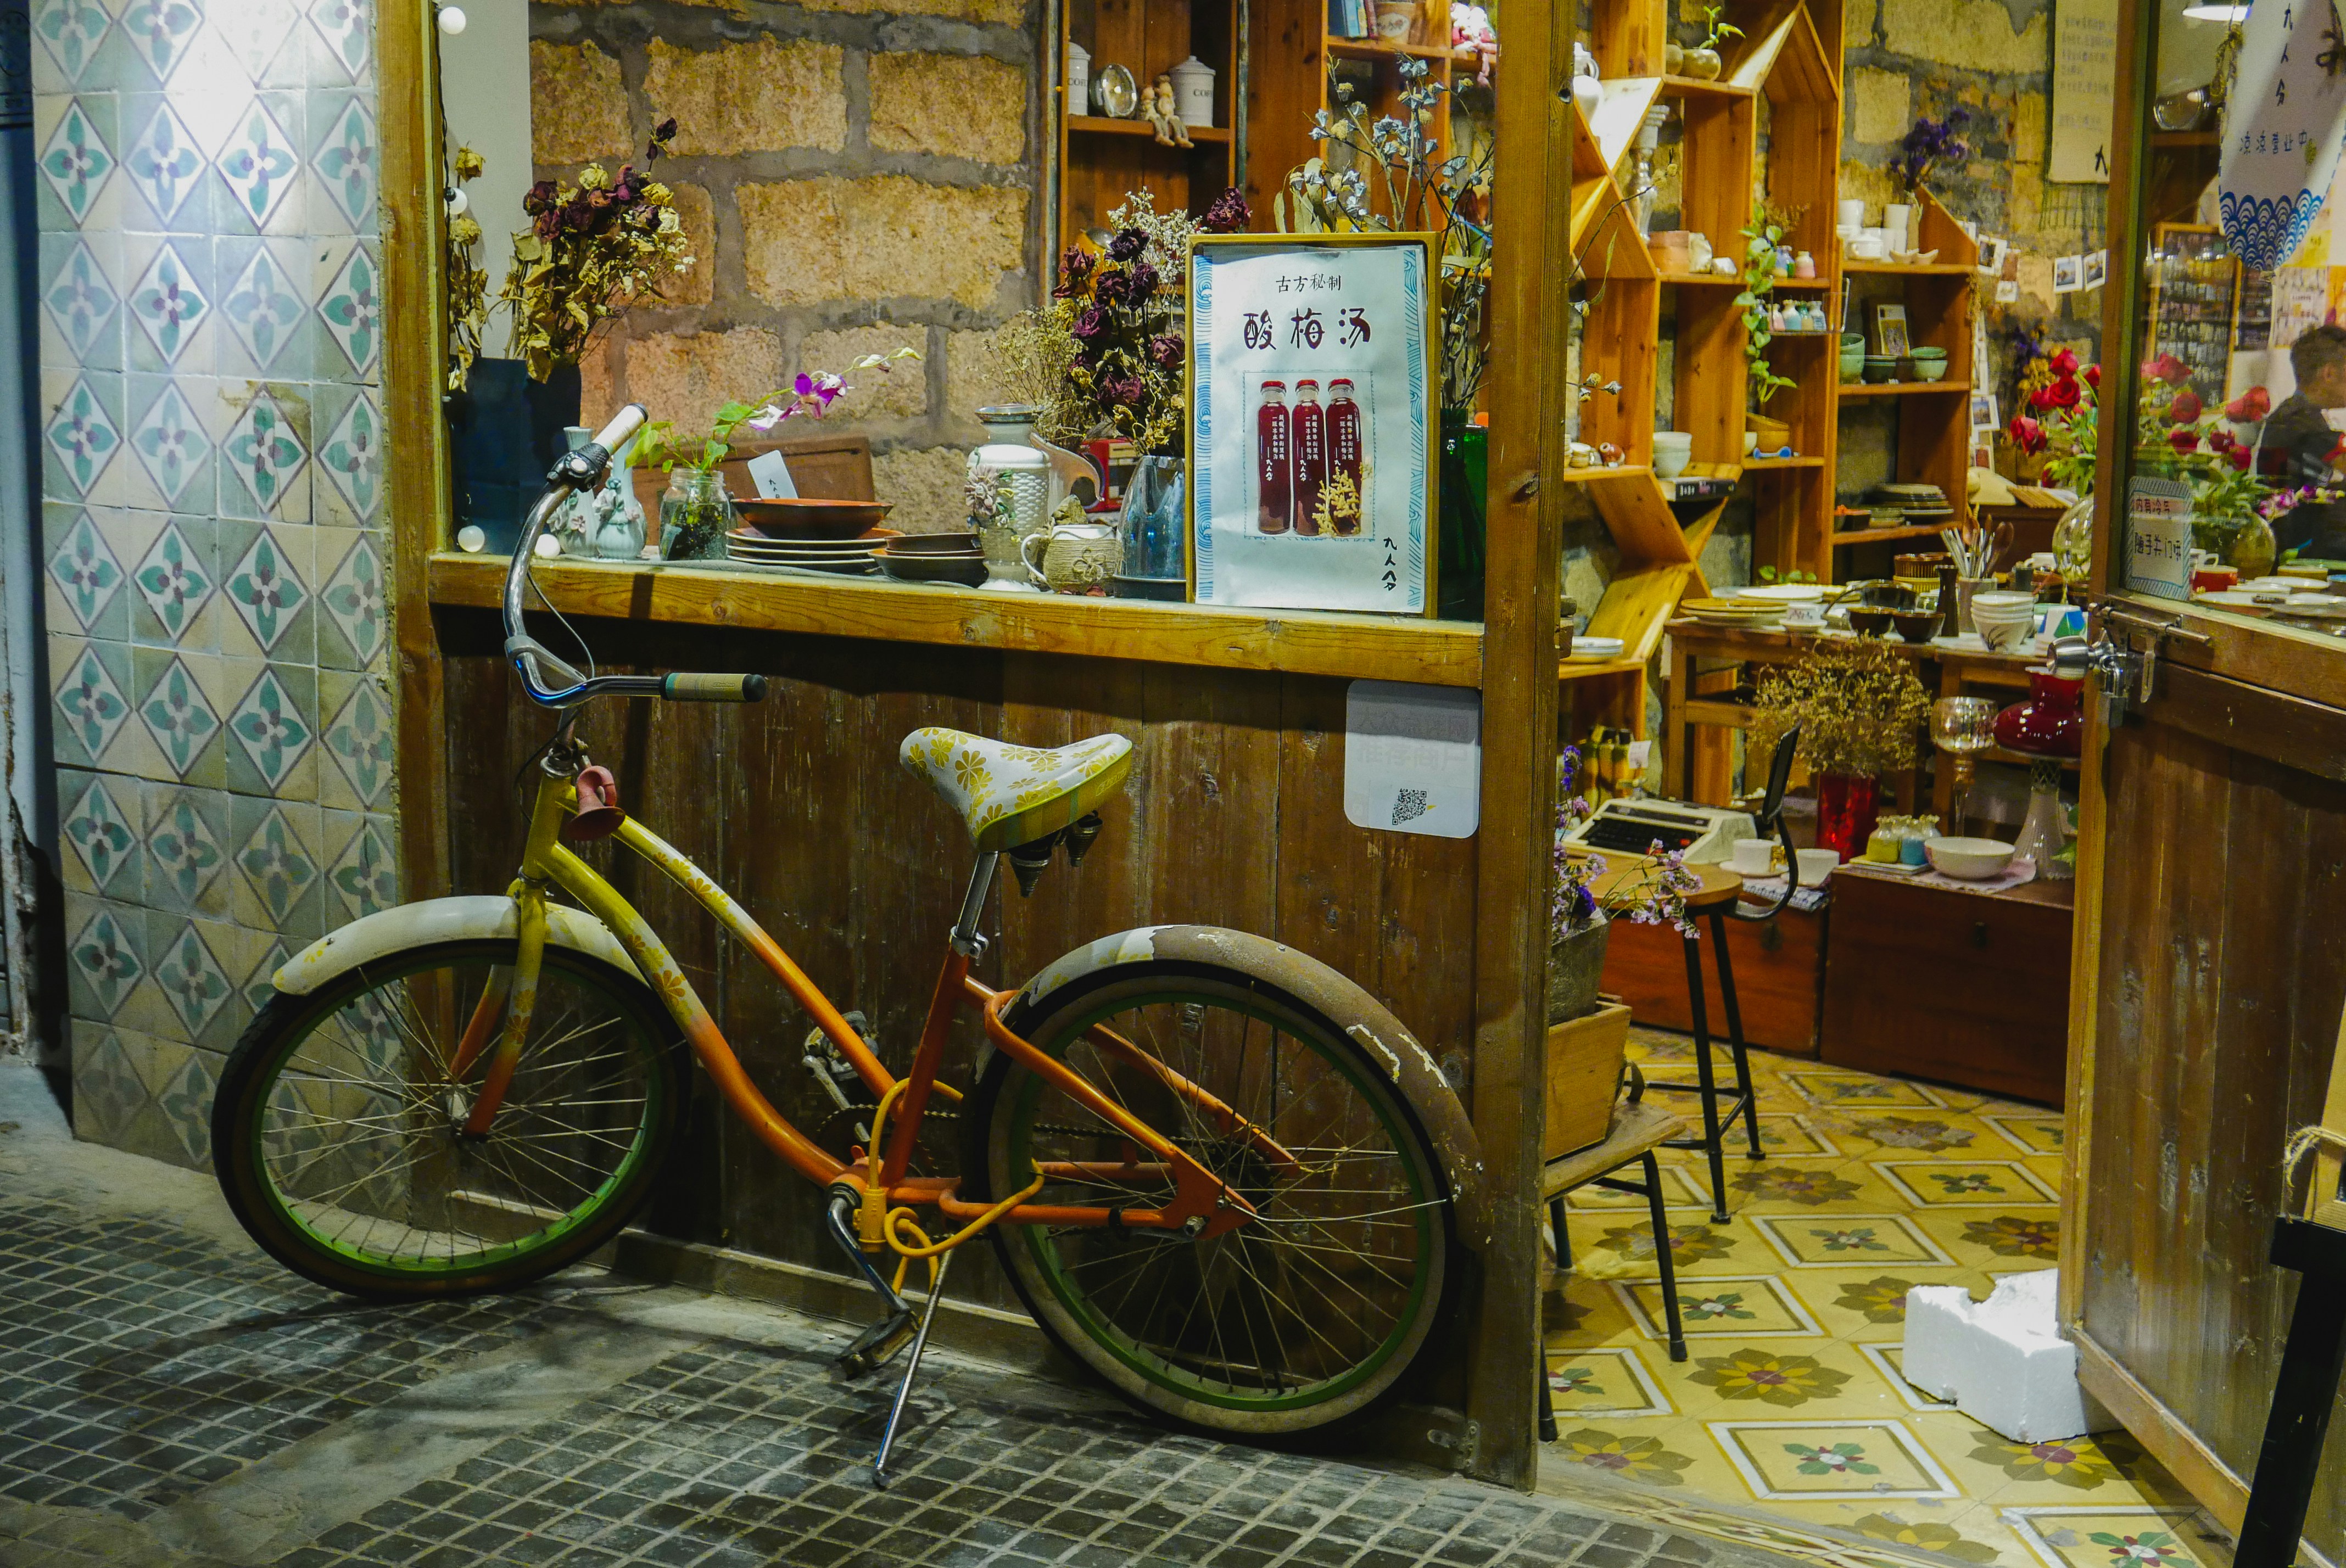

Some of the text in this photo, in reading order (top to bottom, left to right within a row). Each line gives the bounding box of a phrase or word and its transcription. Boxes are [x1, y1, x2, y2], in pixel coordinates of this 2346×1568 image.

[1276, 273, 1342, 293] 古方秘制
[1243, 307, 1371, 350] 酸梅汤
